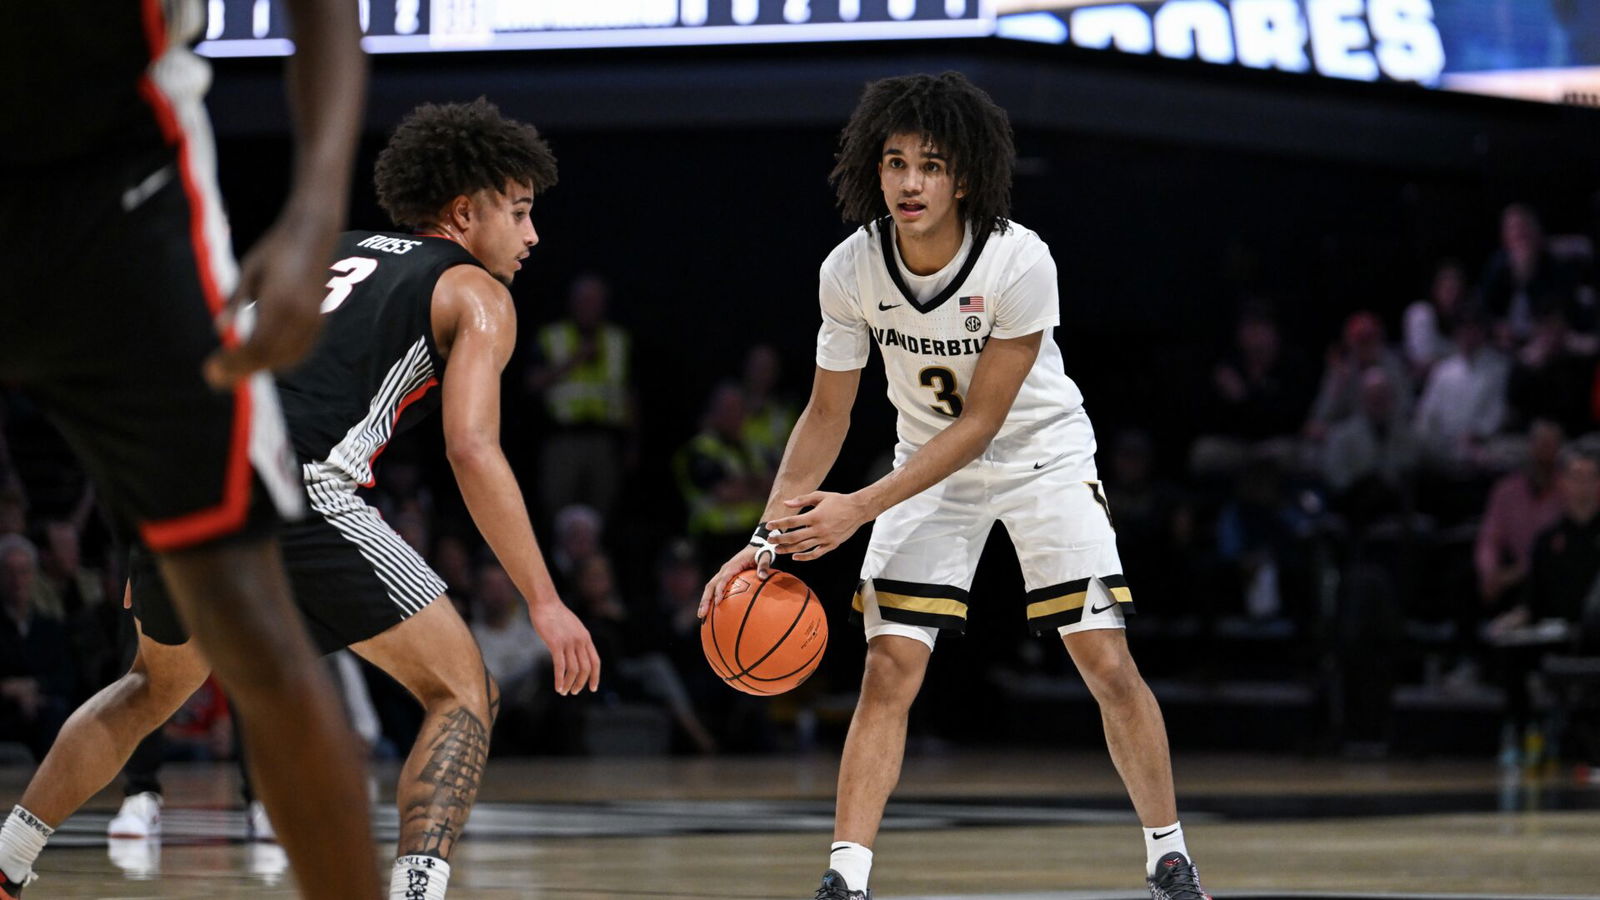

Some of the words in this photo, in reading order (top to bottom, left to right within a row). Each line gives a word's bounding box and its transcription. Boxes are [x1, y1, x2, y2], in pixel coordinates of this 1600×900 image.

[356, 234, 423, 255] ROSS
[320, 256, 379, 315] 3
[966, 316, 981, 331] SEC
[918, 366, 964, 418] 3
